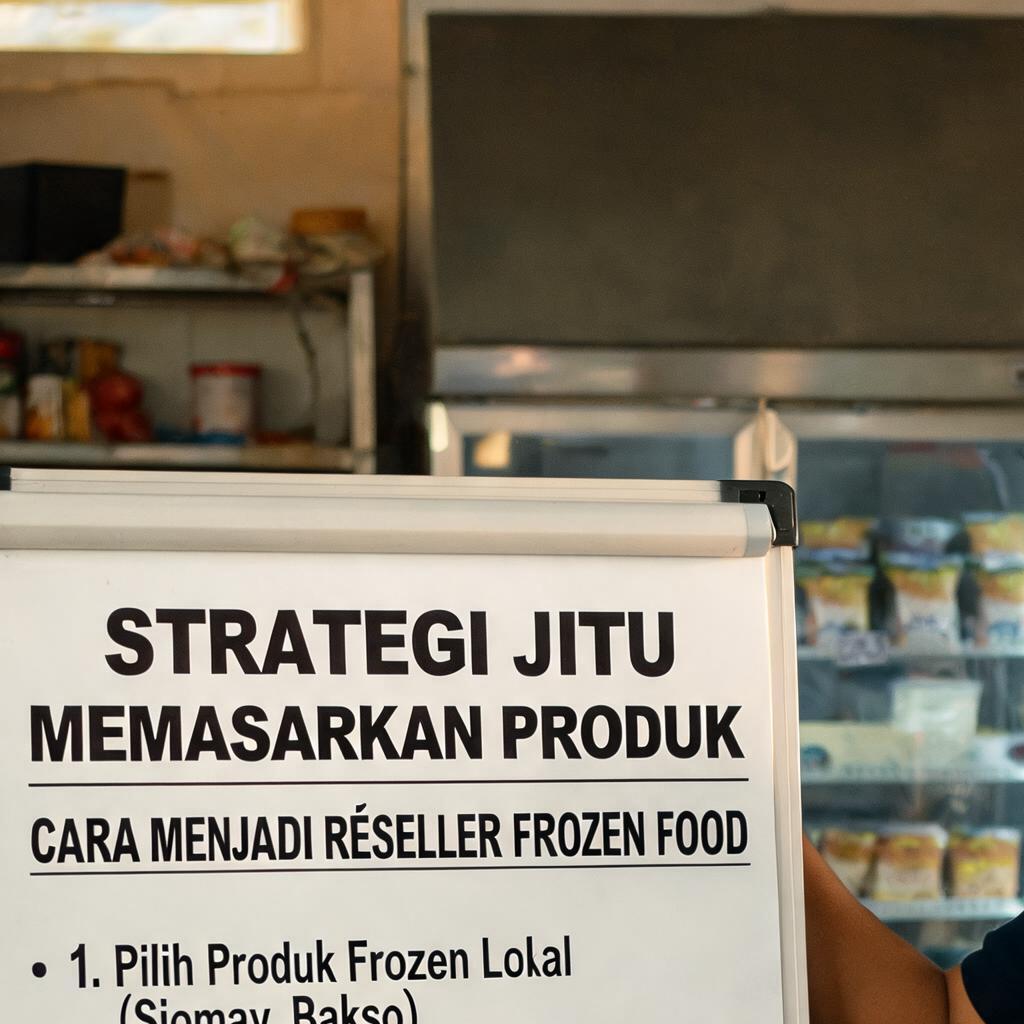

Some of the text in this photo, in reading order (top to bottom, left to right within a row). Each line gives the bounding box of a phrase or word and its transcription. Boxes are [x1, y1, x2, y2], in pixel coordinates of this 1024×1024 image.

[104, 607, 675, 678] STRATEGI JITU
[30, 704, 745, 762] MEMASARKAN PRODUK
[31, 802, 748, 864] CARA MENJADI RÉSELLER FROZEN FOOD
[70, 935, 572, 989] 1. Pilih Produk Frozen Lokal
